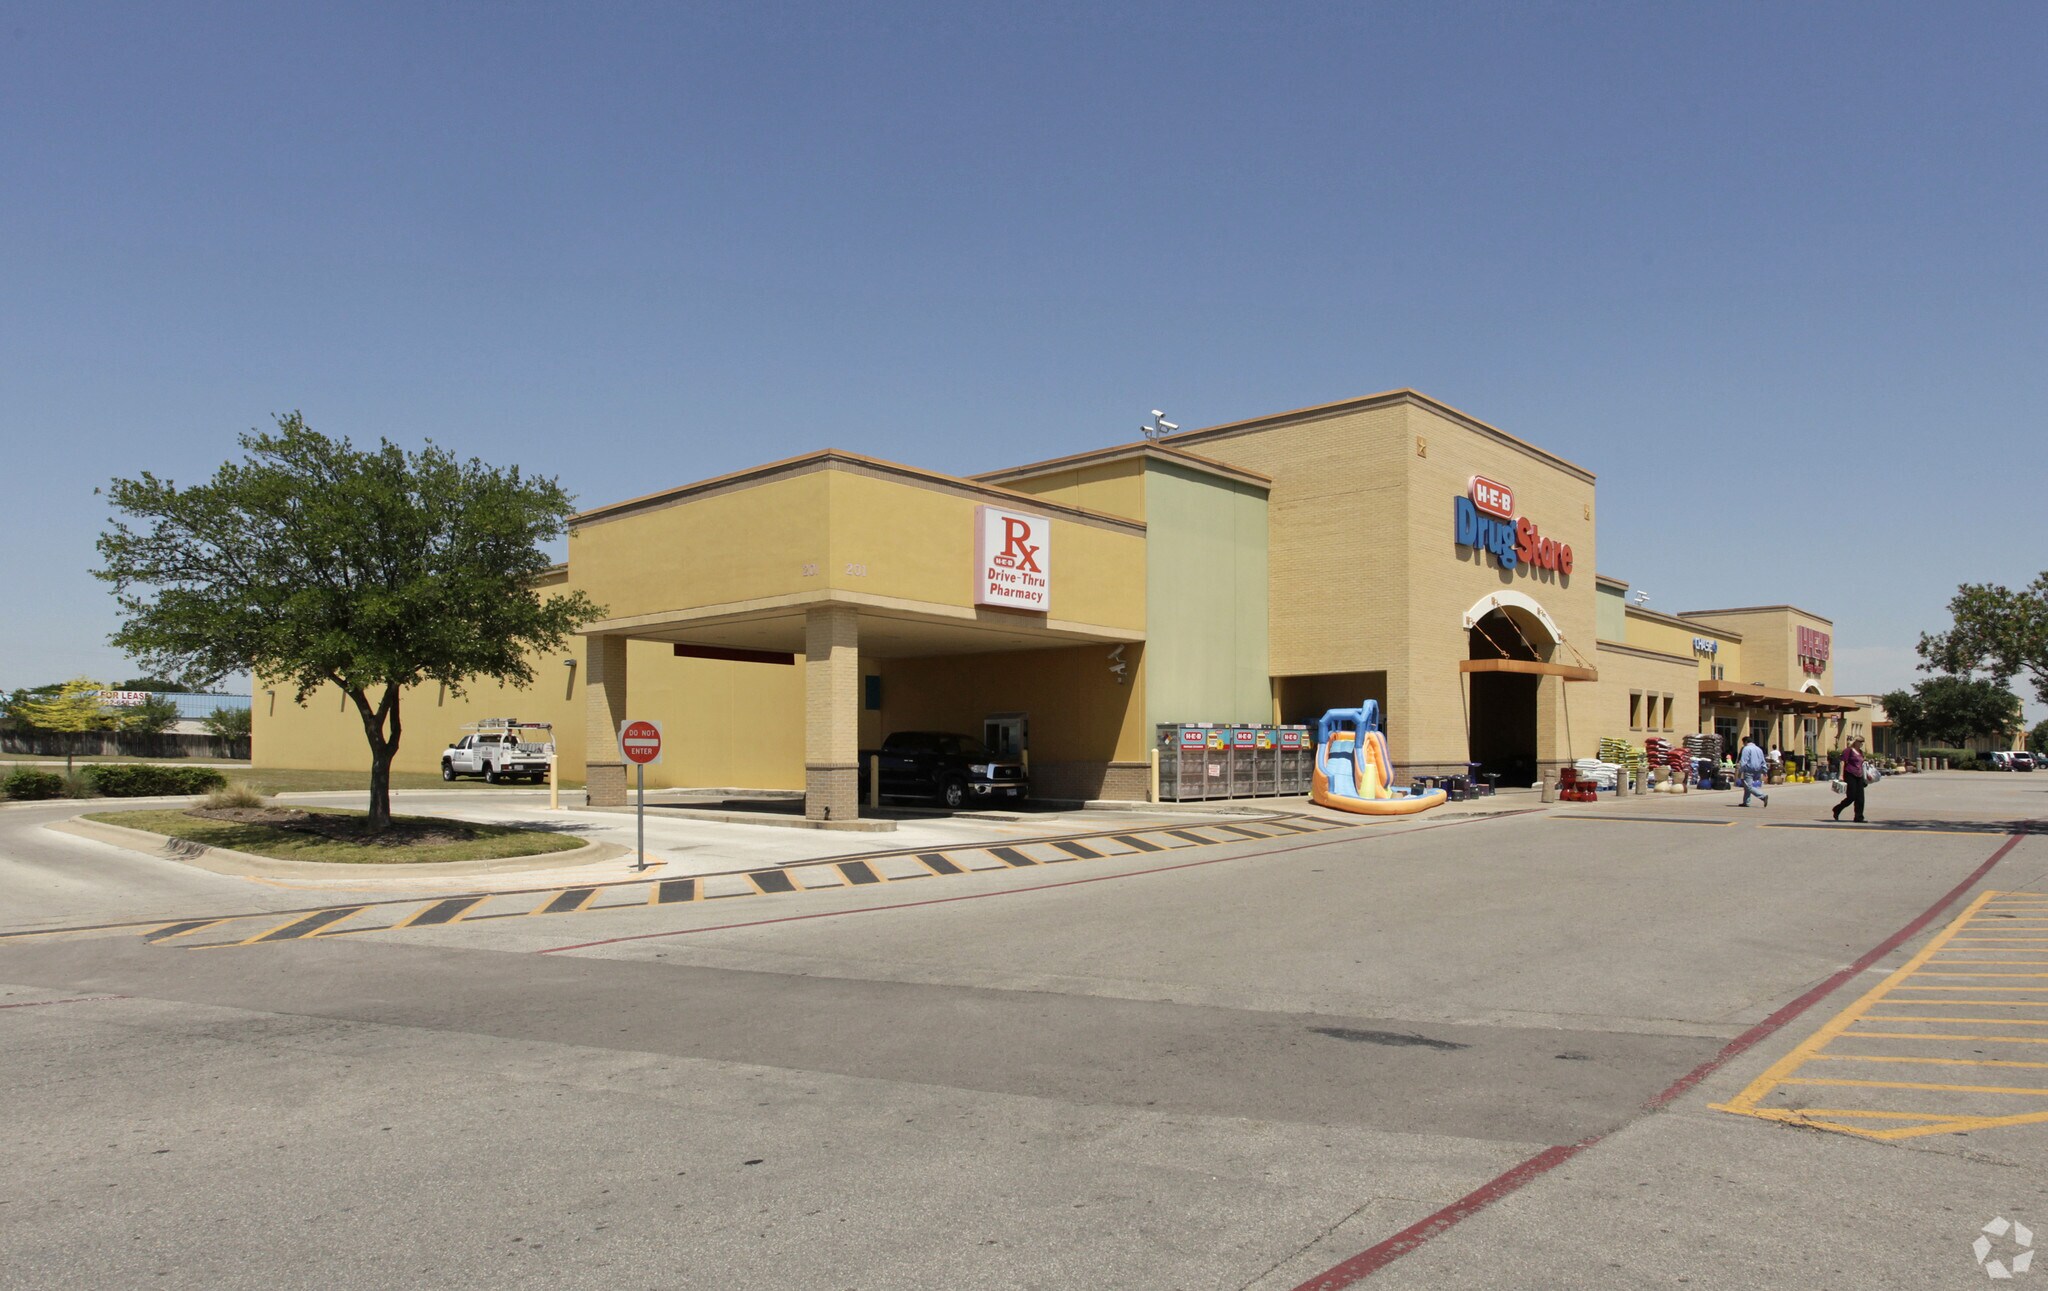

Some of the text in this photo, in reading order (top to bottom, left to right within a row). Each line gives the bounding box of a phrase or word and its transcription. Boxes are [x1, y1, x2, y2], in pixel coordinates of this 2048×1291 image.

[1001, 516, 1042, 573] Rx
[1454, 496, 1573, 575] Drug Store
[847, 563, 867, 577] 201
[988, 567, 1046, 588] Drive-Thru
[990, 582, 1044, 604] Pharmacy
[1693, 637, 1713, 653] CHASE
[100, 691, 151, 700] FOR LEASE
